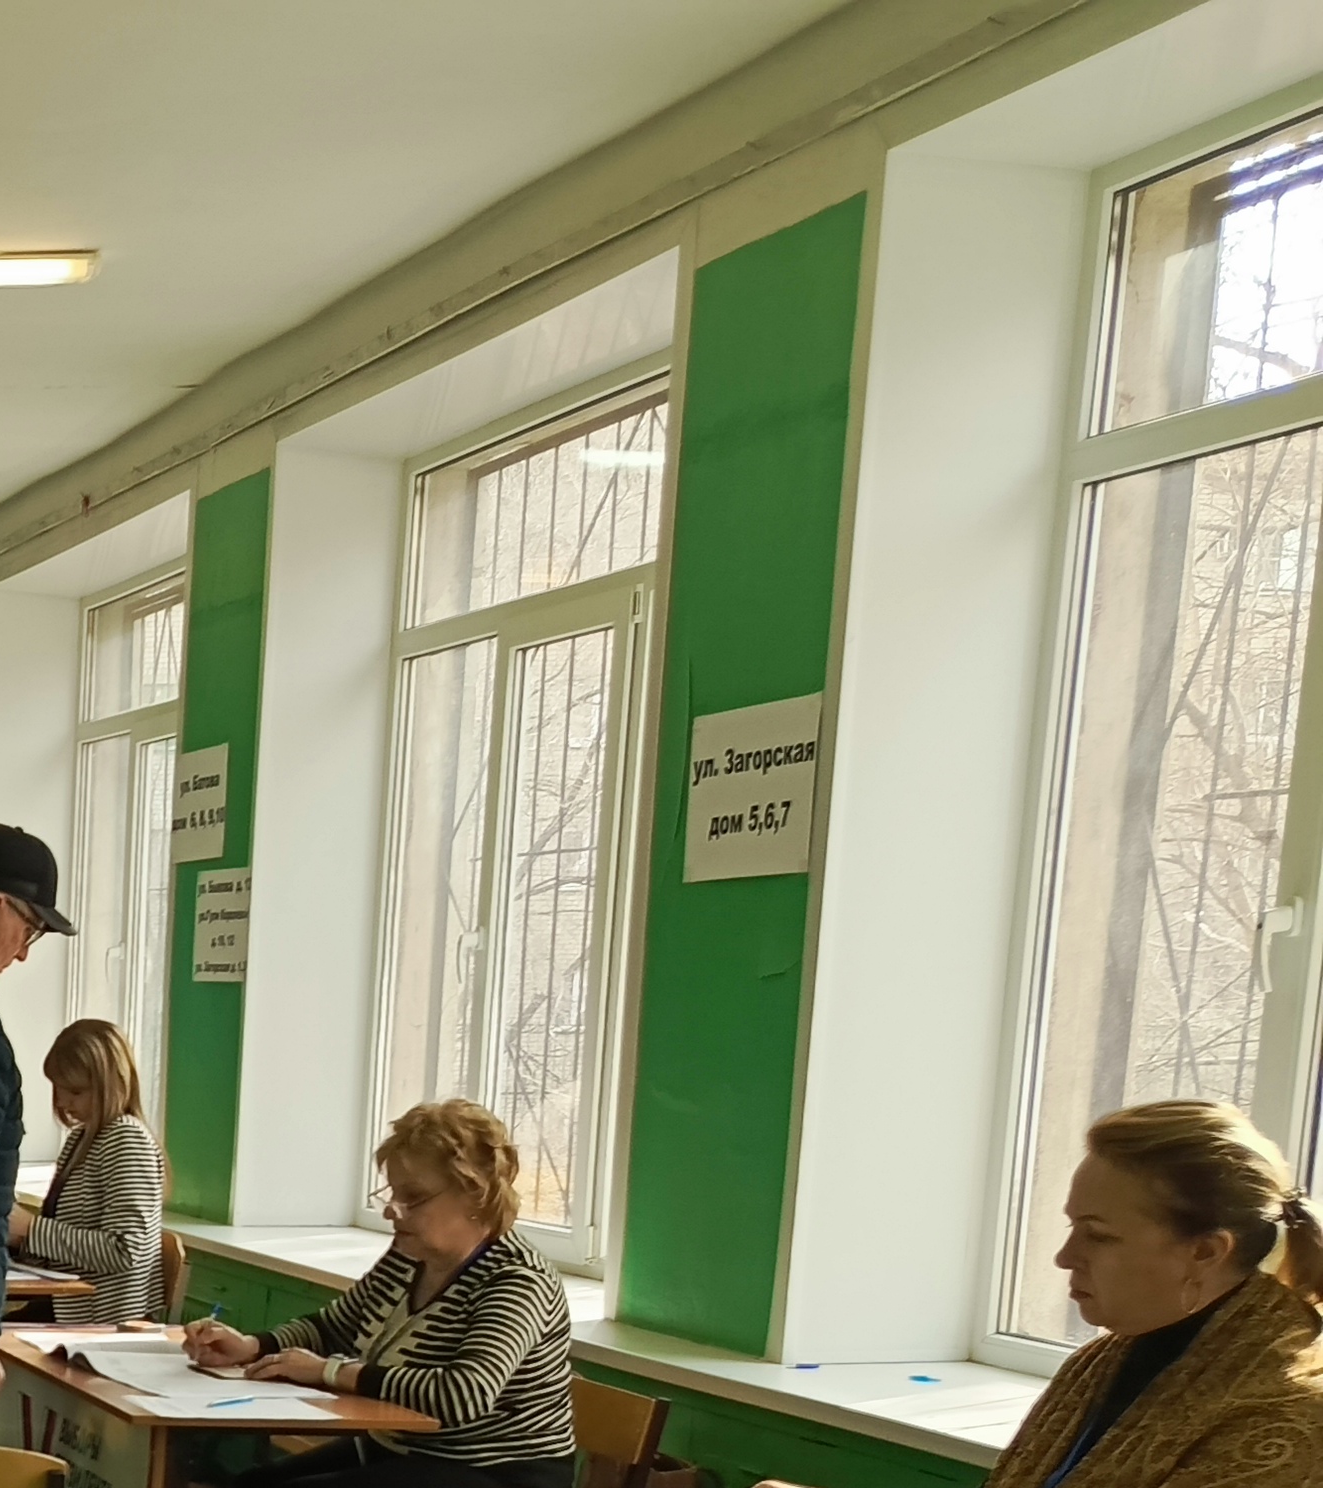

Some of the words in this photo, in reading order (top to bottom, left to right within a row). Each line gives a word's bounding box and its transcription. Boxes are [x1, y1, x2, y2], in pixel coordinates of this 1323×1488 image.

[692, 757, 719, 787] ул.
[724, 740, 816, 776] Загорская
[708, 813, 744, 842] дом
[748, 800, 792, 836] 5,6,7
